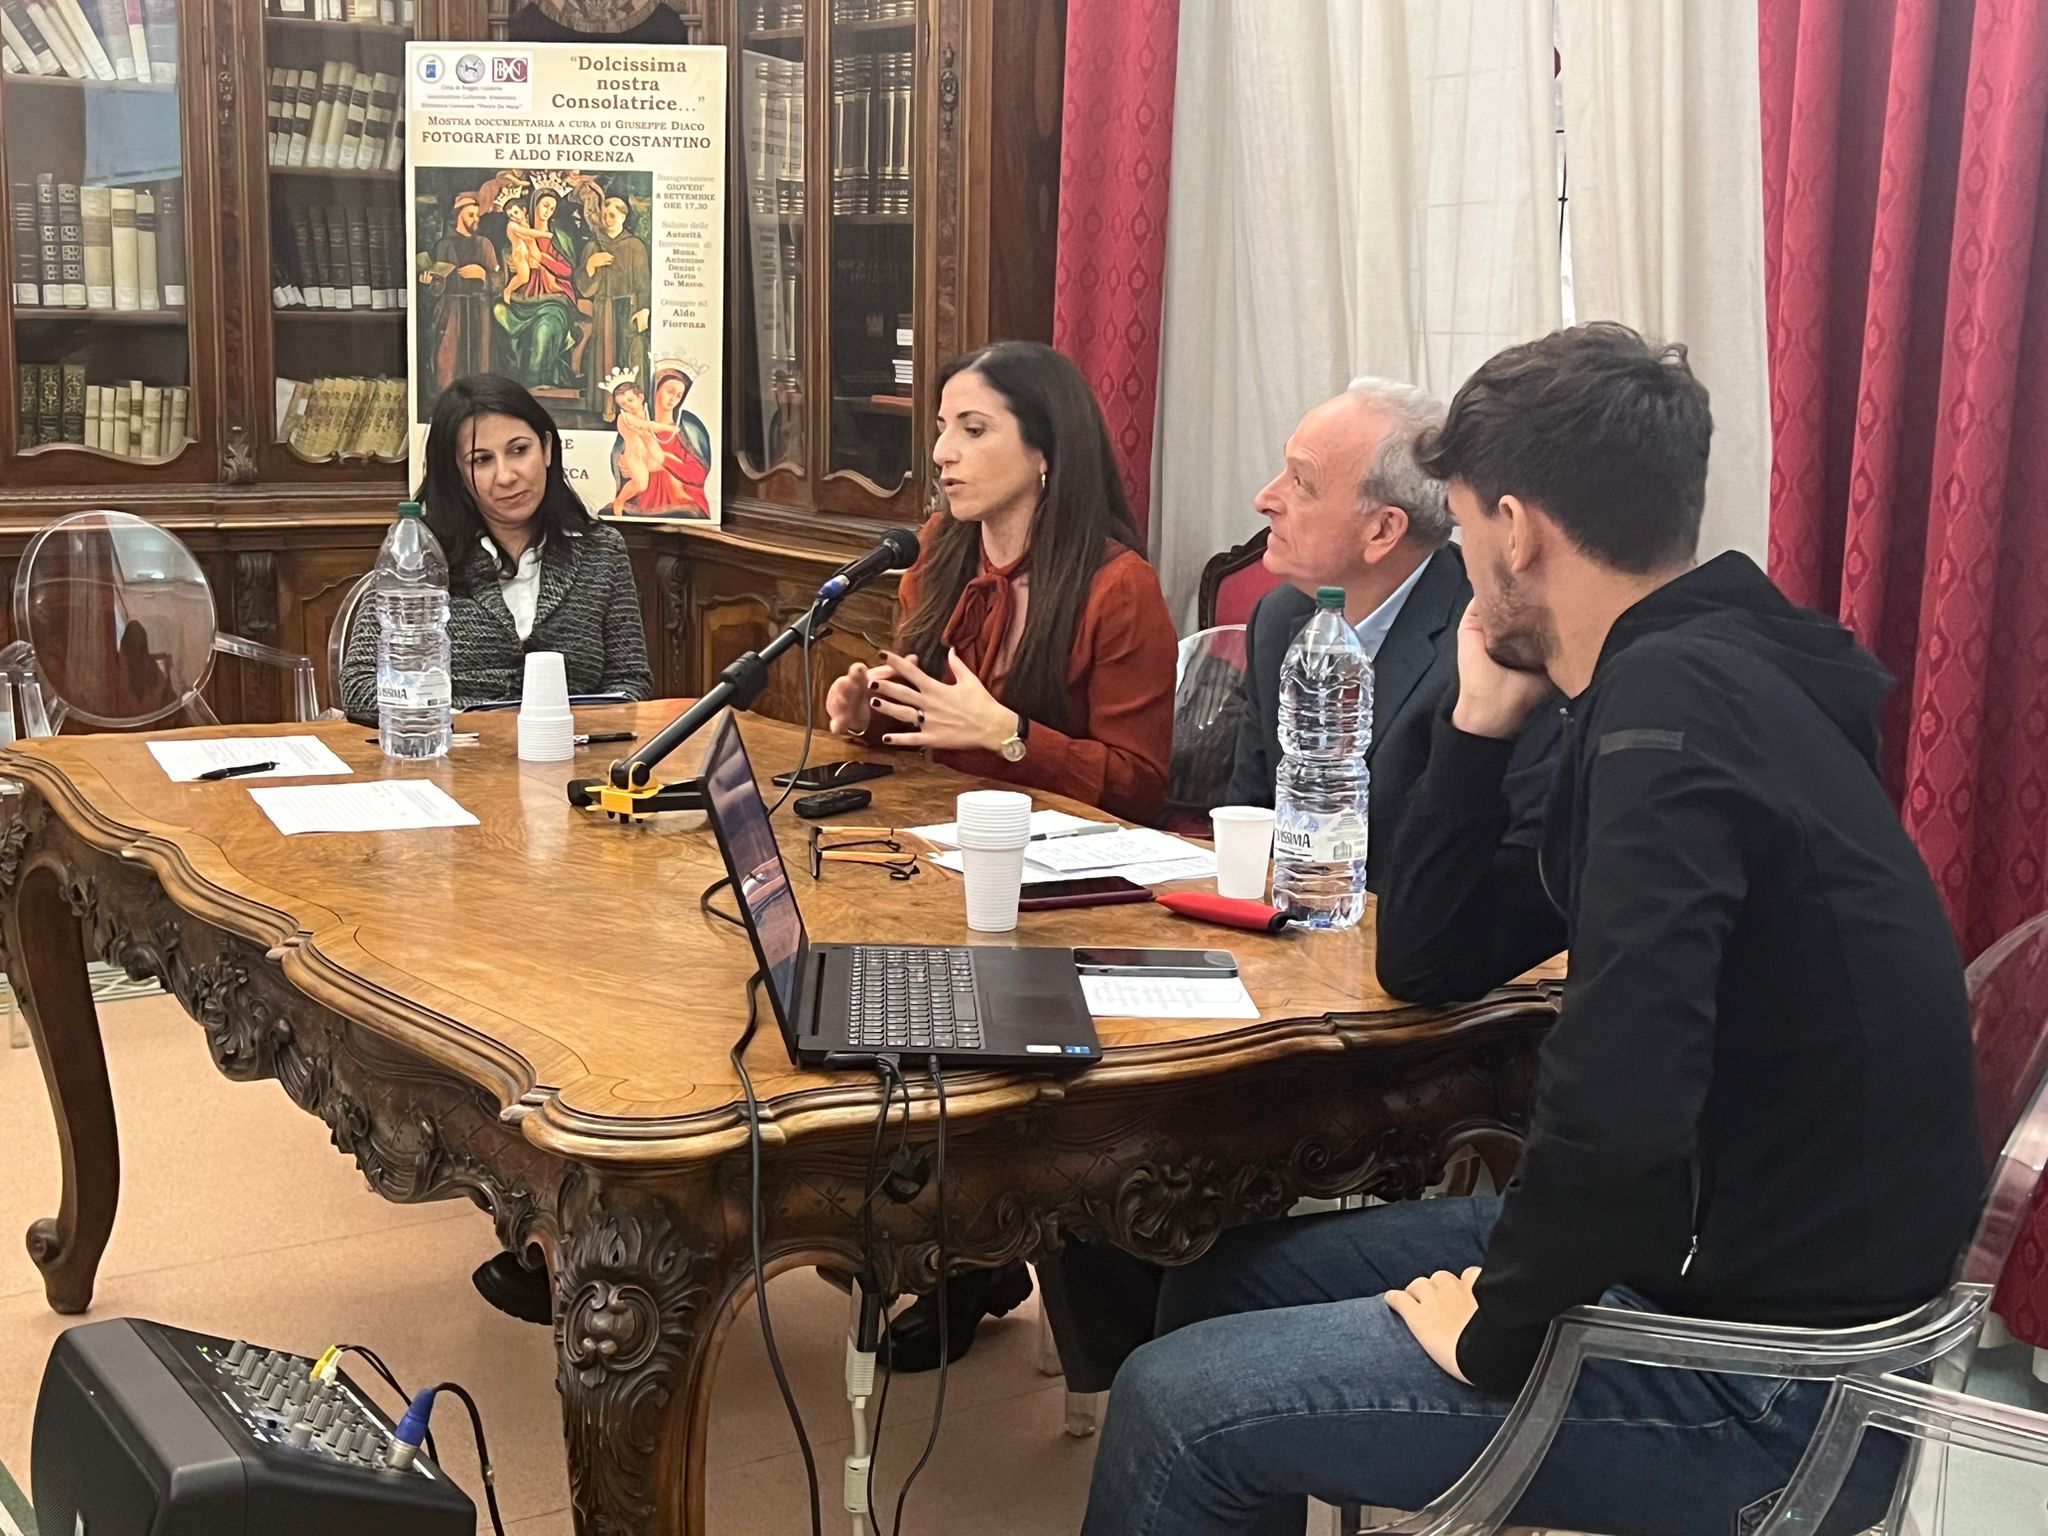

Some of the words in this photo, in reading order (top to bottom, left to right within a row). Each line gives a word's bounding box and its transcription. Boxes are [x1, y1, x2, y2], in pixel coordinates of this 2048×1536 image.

[570, 55, 687, 73] “Dolcissima
[596, 77, 660, 91] nostra
[428, 116, 471, 127] MOSTRA
[475, 118, 555, 128] DOCUMENTARIA
[558, 120, 565, 128] A
[569, 120, 597, 129] CURA
[600, 121, 611, 129] DI
[615, 120, 667, 130] GIUSEPPE
[671, 121, 705, 131] DIACO
[422, 131, 521, 144] FOTOGRAFIE
[526, 133, 542, 145] DI
[548, 134, 604, 146] MARCO
[609, 135, 711, 149] COSTANTINO
[495, 149, 504, 160] E
[509, 149, 551, 161] ALDO
[556, 150, 634, 163] FIORENZA
[672, 309, 696, 317] Aldo
[662, 319, 706, 329] Fiorenza
